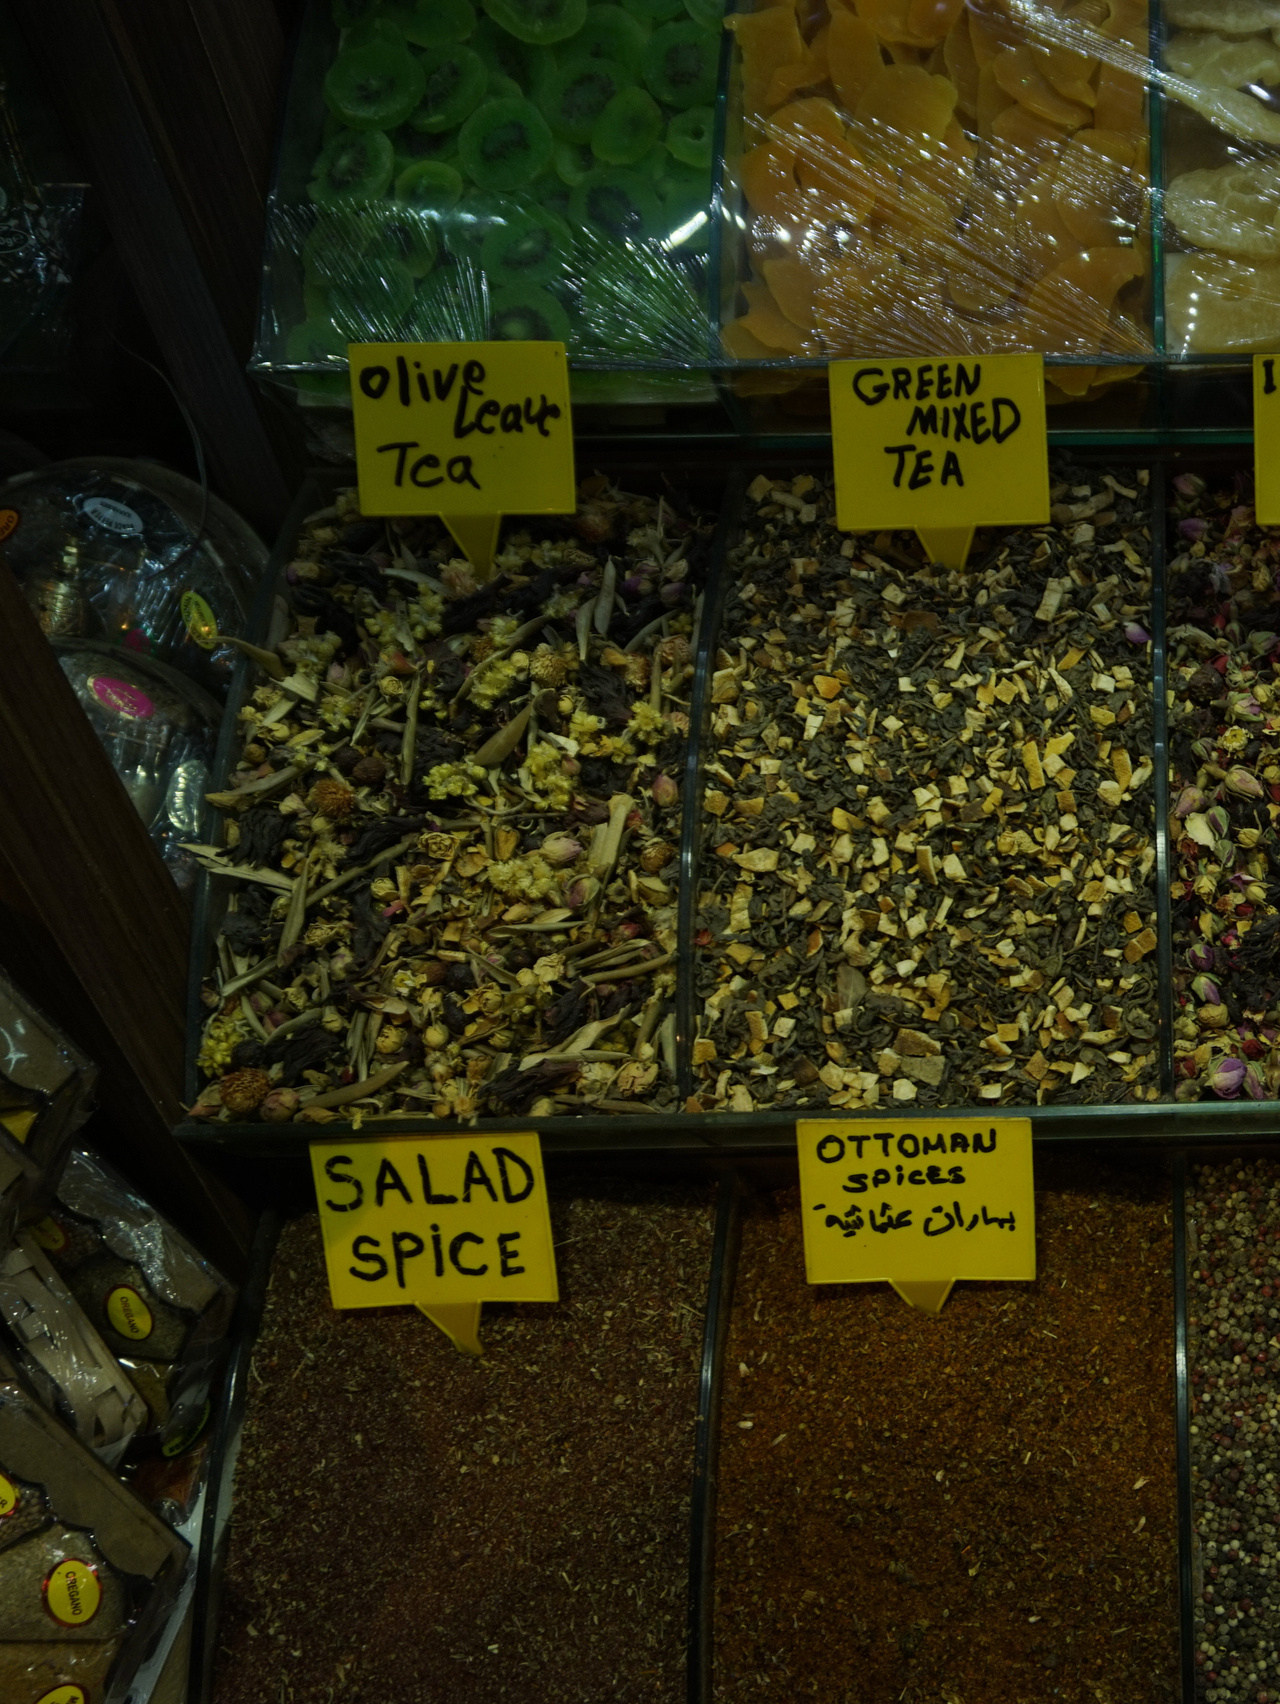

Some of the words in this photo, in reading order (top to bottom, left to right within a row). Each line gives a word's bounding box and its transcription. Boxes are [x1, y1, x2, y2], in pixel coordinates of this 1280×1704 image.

[853, 363, 981, 406] GREEN
[906, 397, 1021, 444] MIXED
[377, 441, 481, 490] Tea
[884, 444, 964, 490] TEA
[816, 1128, 996, 1163] OTTOMAN
[325, 1147, 534, 1212] SALAD
[119, 1295, 139, 1335] OREGANO
[65, 1570, 83, 1616] OREGANO
